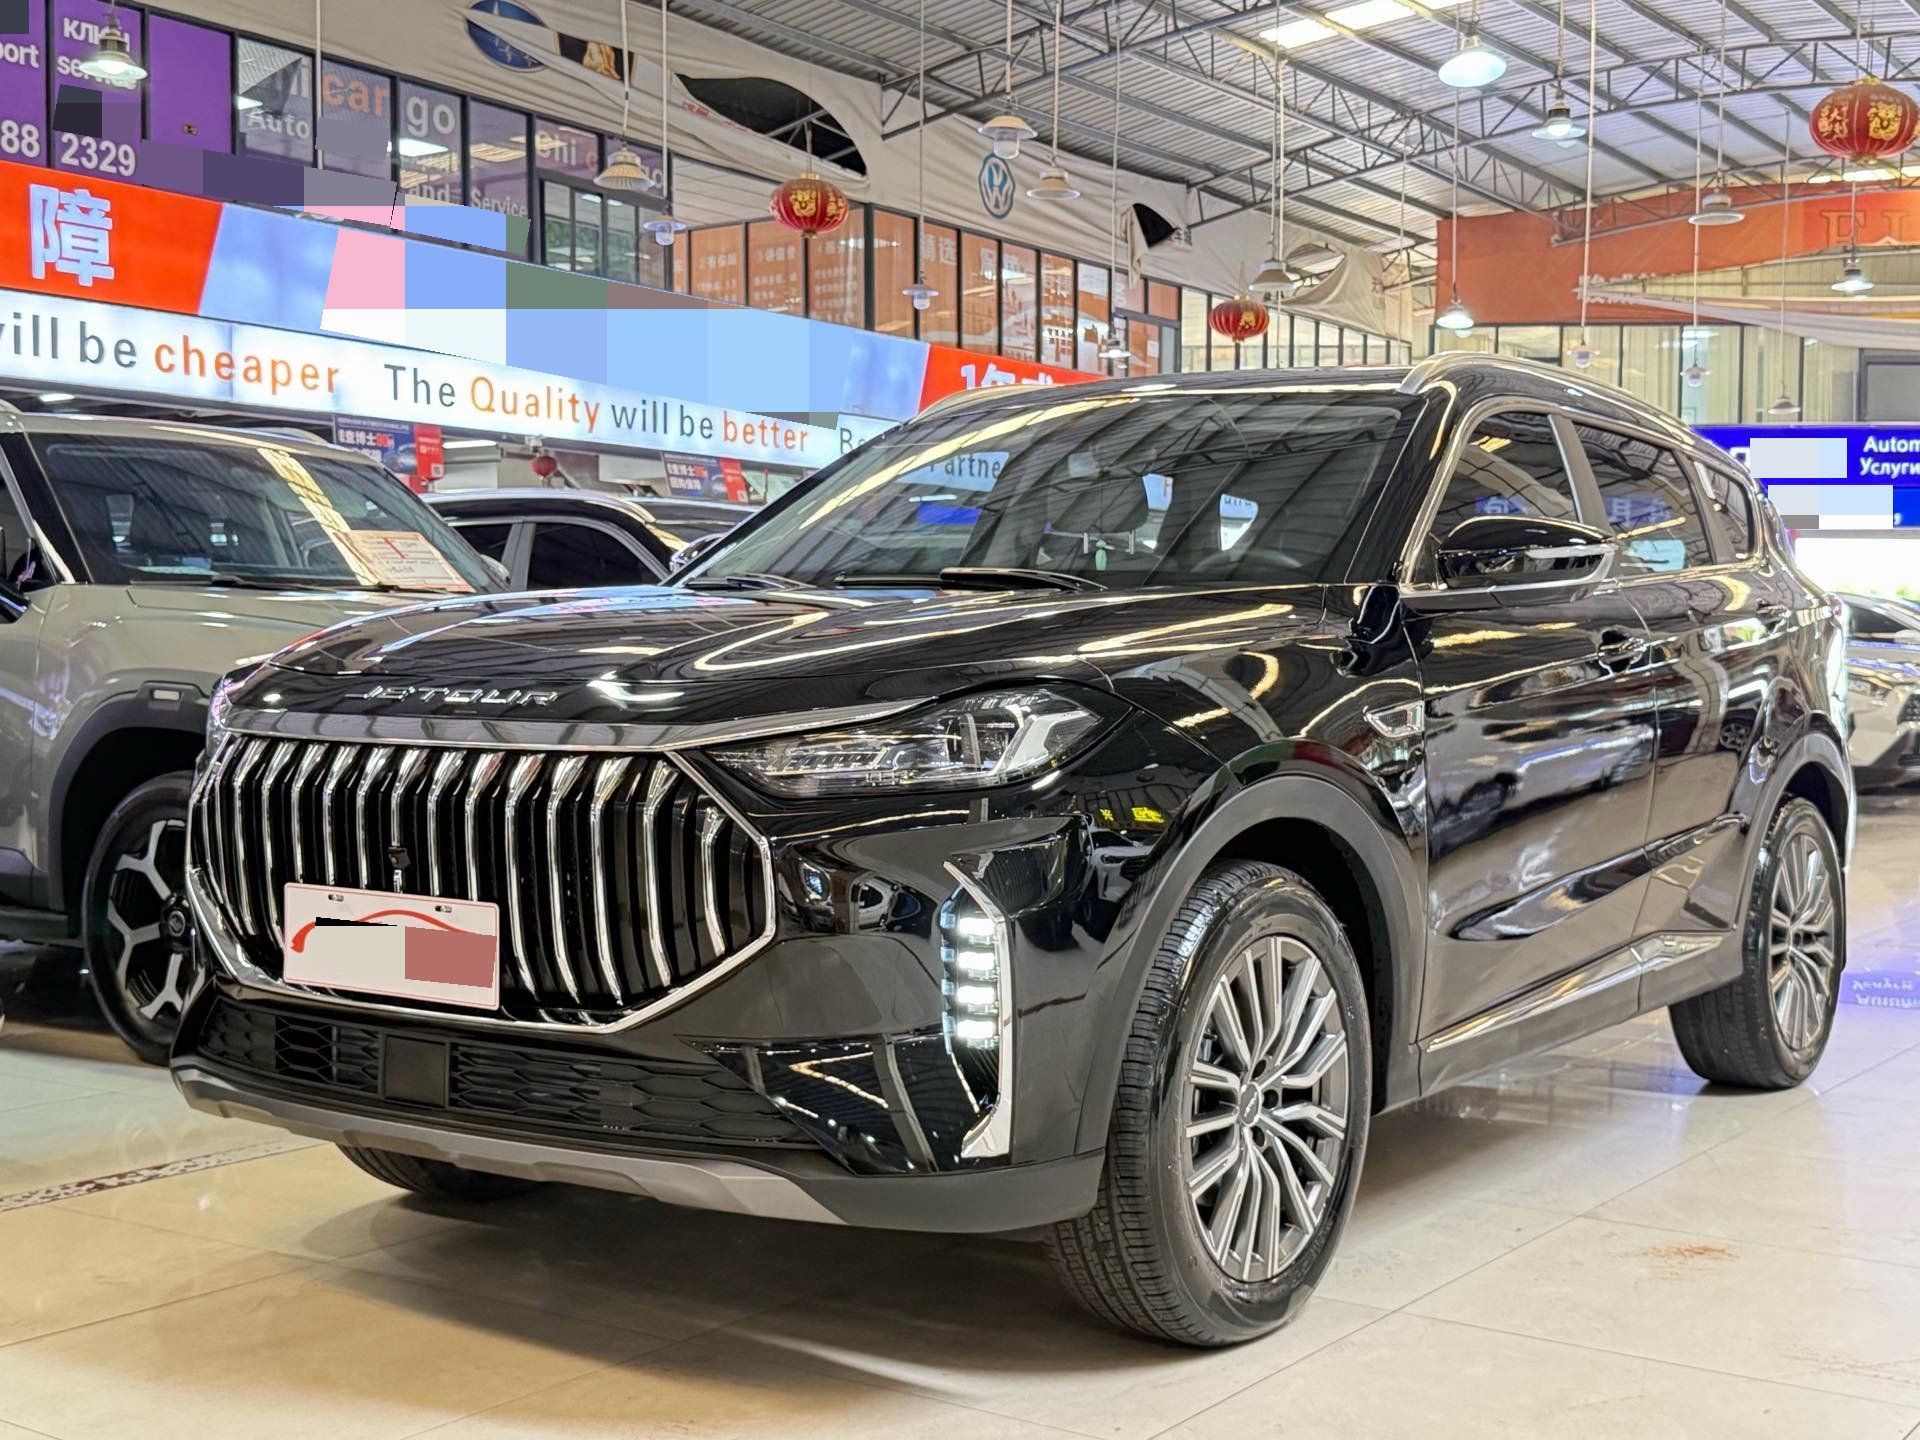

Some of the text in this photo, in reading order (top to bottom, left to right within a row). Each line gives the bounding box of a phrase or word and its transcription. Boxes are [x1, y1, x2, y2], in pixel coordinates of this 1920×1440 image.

[248, 109, 310, 139] Auto
[323, 71, 387, 117] car
[406, 95, 456, 138] go
[1, 120, 136, 177] 88 2329
[471, 186, 528, 217] Service
[29, 183, 115, 287] 障
[0, 311, 59, 359] ill
[79, 320, 137, 368] be
[155, 335, 340, 396] cheaper
[384, 363, 456, 407] The
[470, 375, 600, 431] Quality
[611, 398, 669, 435] will
[679, 404, 714, 440] be
[722, 410, 809, 452] better
[1859, 457, 1920, 479] Услуги
[345, 685, 559, 707] JETOUR
